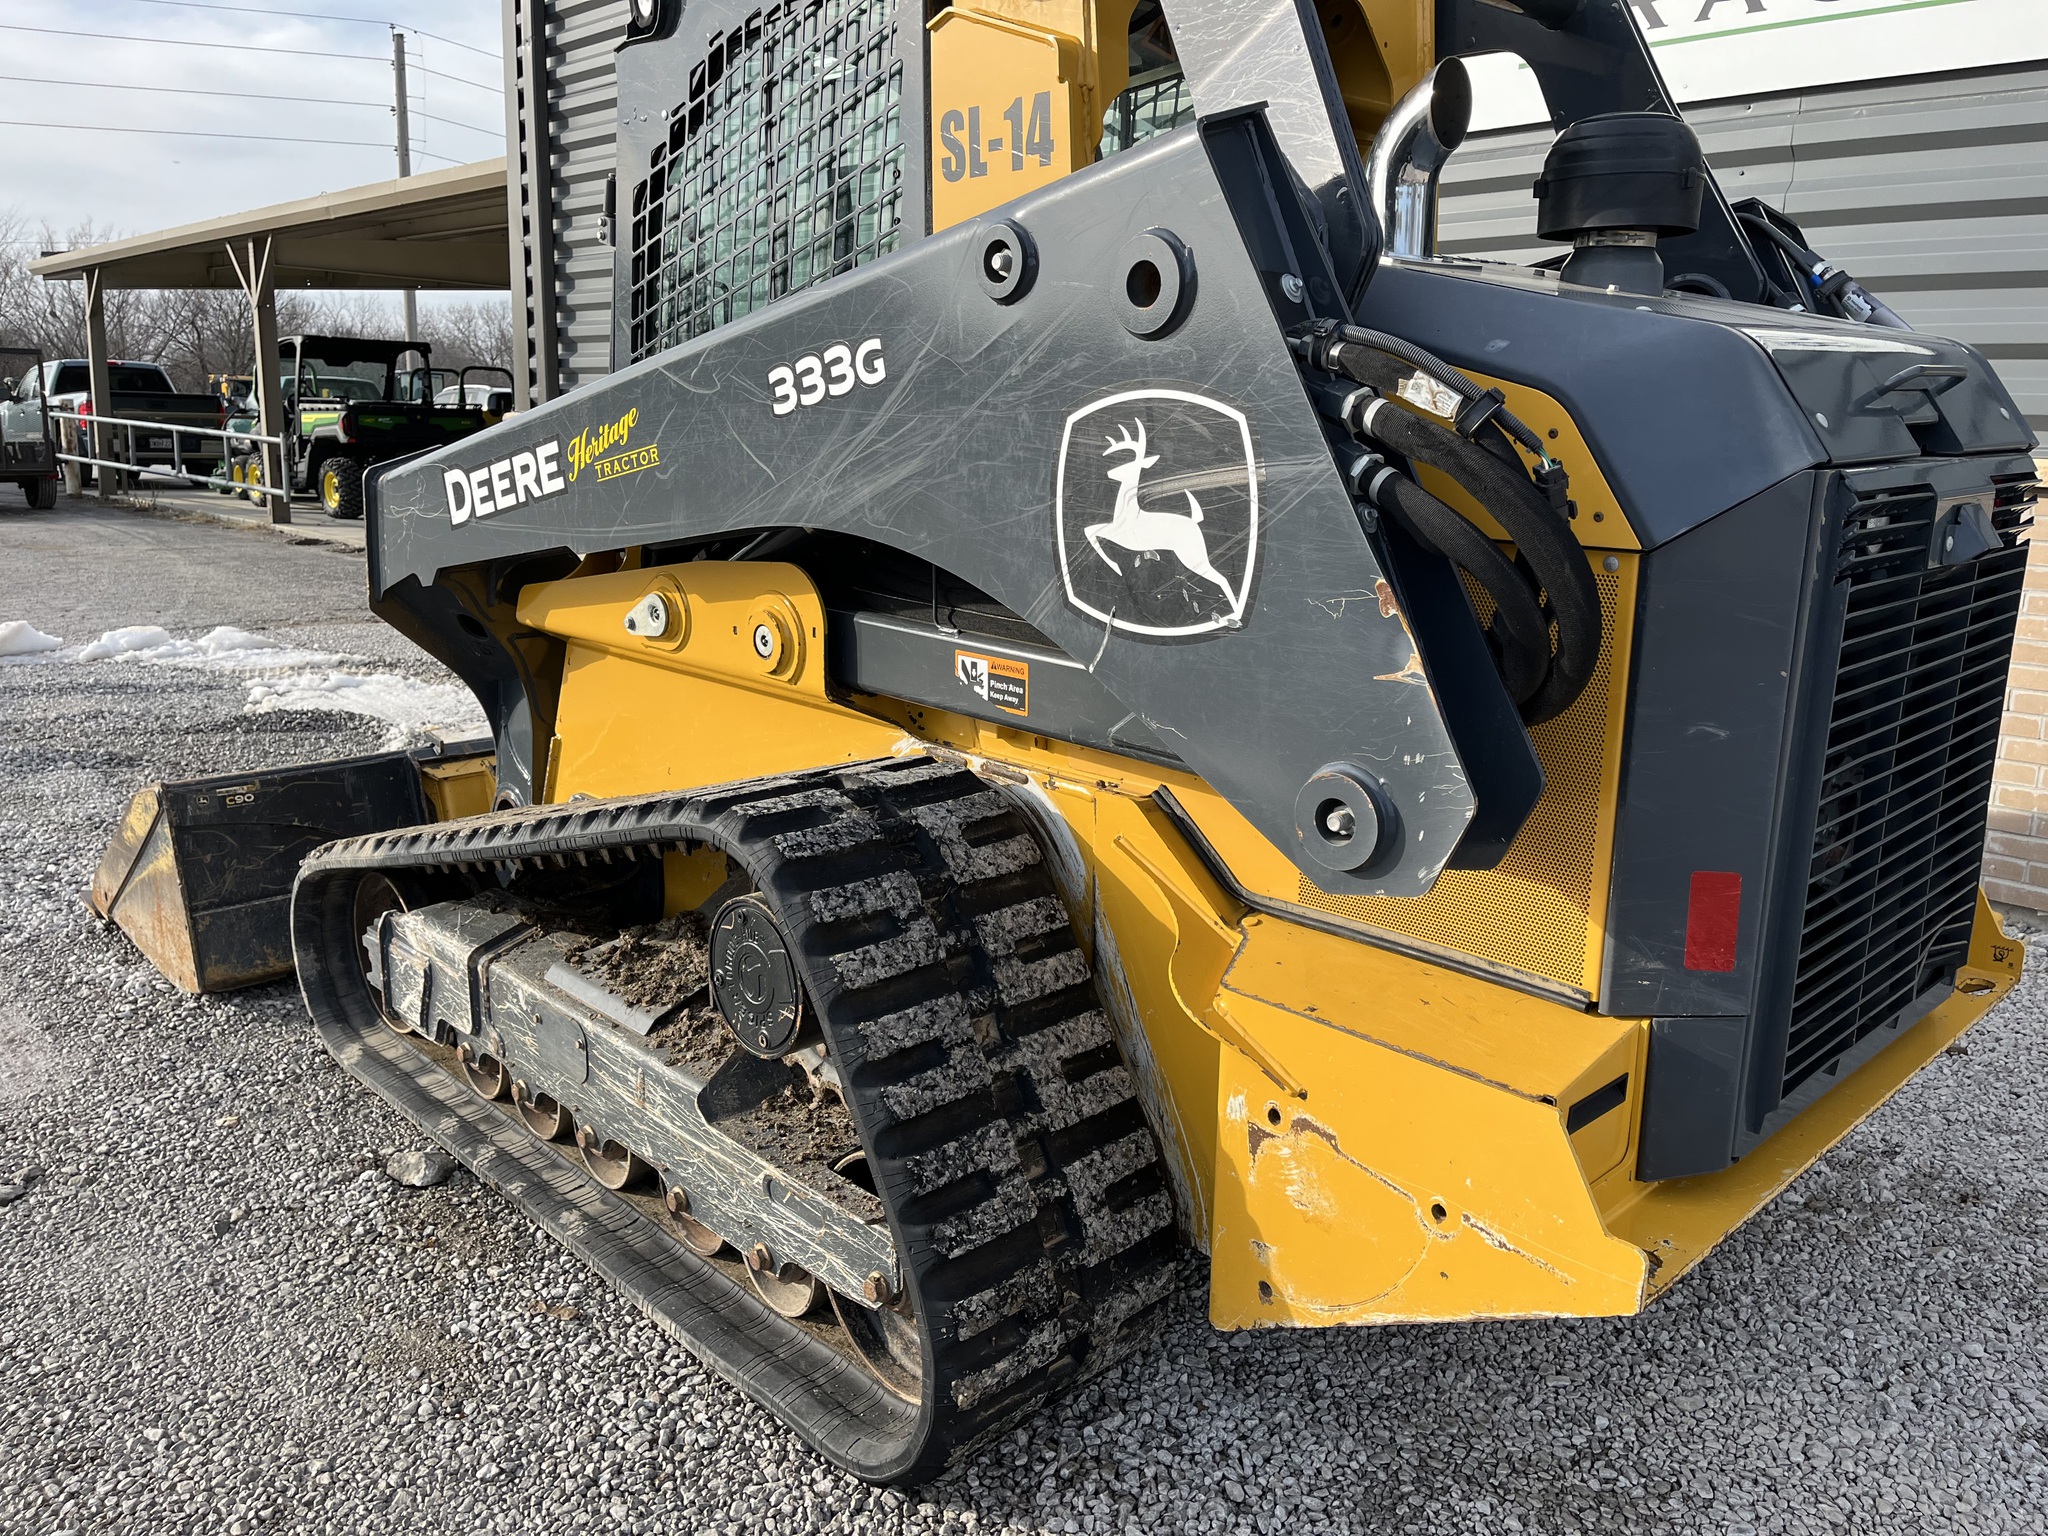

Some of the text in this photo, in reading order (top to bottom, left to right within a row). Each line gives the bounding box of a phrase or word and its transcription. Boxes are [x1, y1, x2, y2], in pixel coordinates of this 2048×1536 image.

[940, 90, 1055, 183] SL-14
[768, 338, 887, 415] 333G
[567, 407, 640, 482] Heritage
[594, 447, 660, 479] TRACTOR
[444, 440, 566, 526] DEERE
[997, 664, 1025, 675] WARNING
[989, 690, 1019, 705] Keep Away
[990, 679, 1024, 694] Pinch Area
[226, 794, 254, 804] C90
